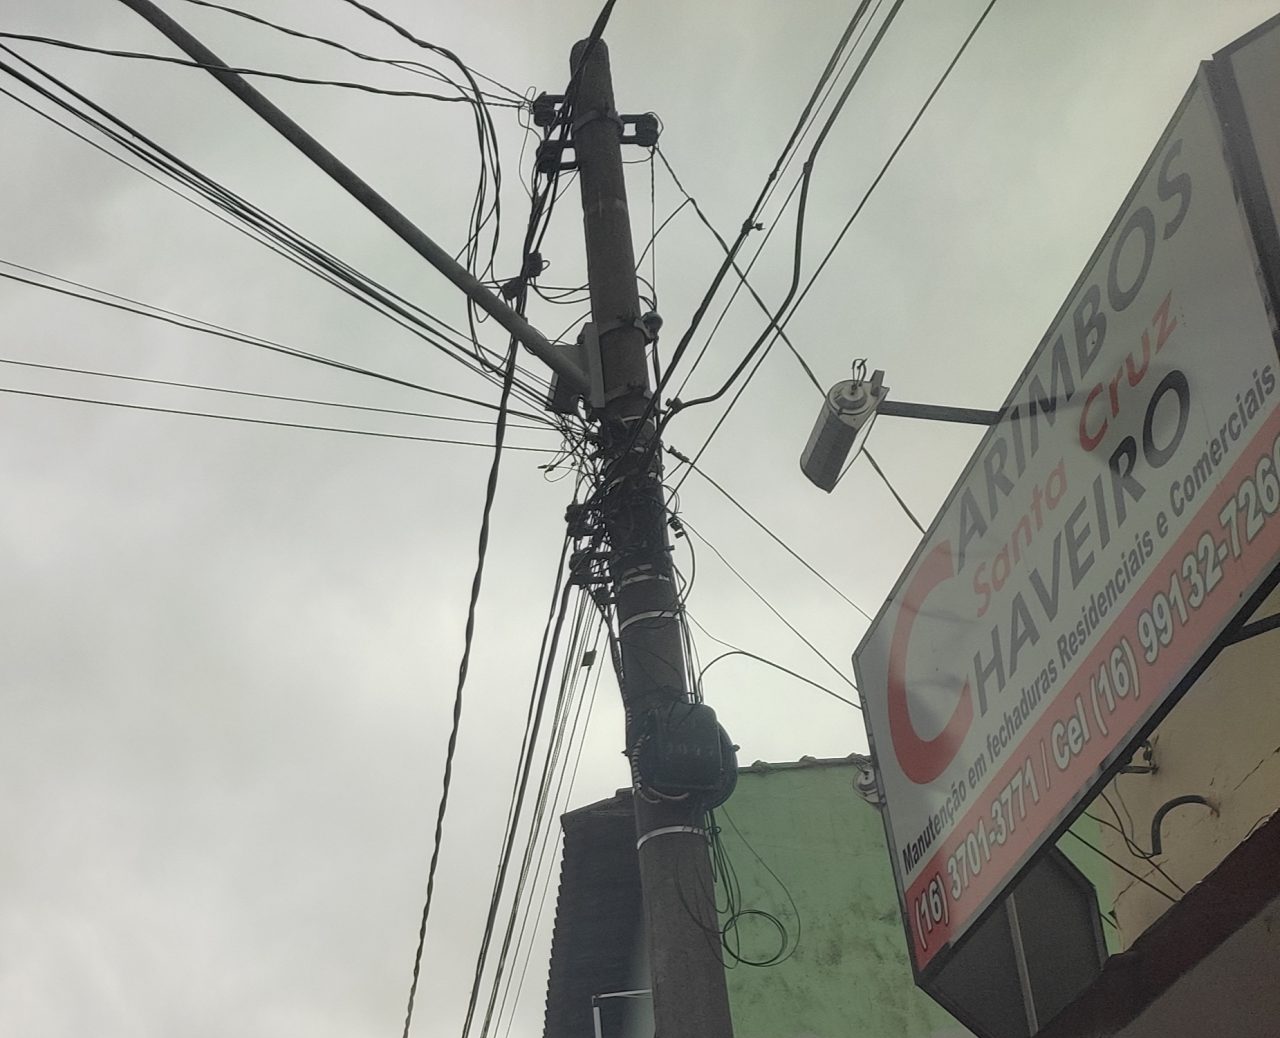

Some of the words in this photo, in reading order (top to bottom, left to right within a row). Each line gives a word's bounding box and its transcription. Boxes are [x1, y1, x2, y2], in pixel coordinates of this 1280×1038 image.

[972, 457, 1069, 618] Santa
[1079, 289, 1178, 452] Cruz
[902, 778, 967, 876] Manutenção
[968, 755, 988, 792] em
[986, 663, 1058, 766] fechaduras
[1059, 528, 1153, 672] Residenciais
[1155, 511, 1169, 539] e
[1169, 363, 1276, 519] Comerciais
[914, 872, 950, 953] (16)
[947, 755, 1041, 902] 3701-3771
[1049, 692, 1092, 772] Cel
[1089, 635, 1143, 738] (16)
